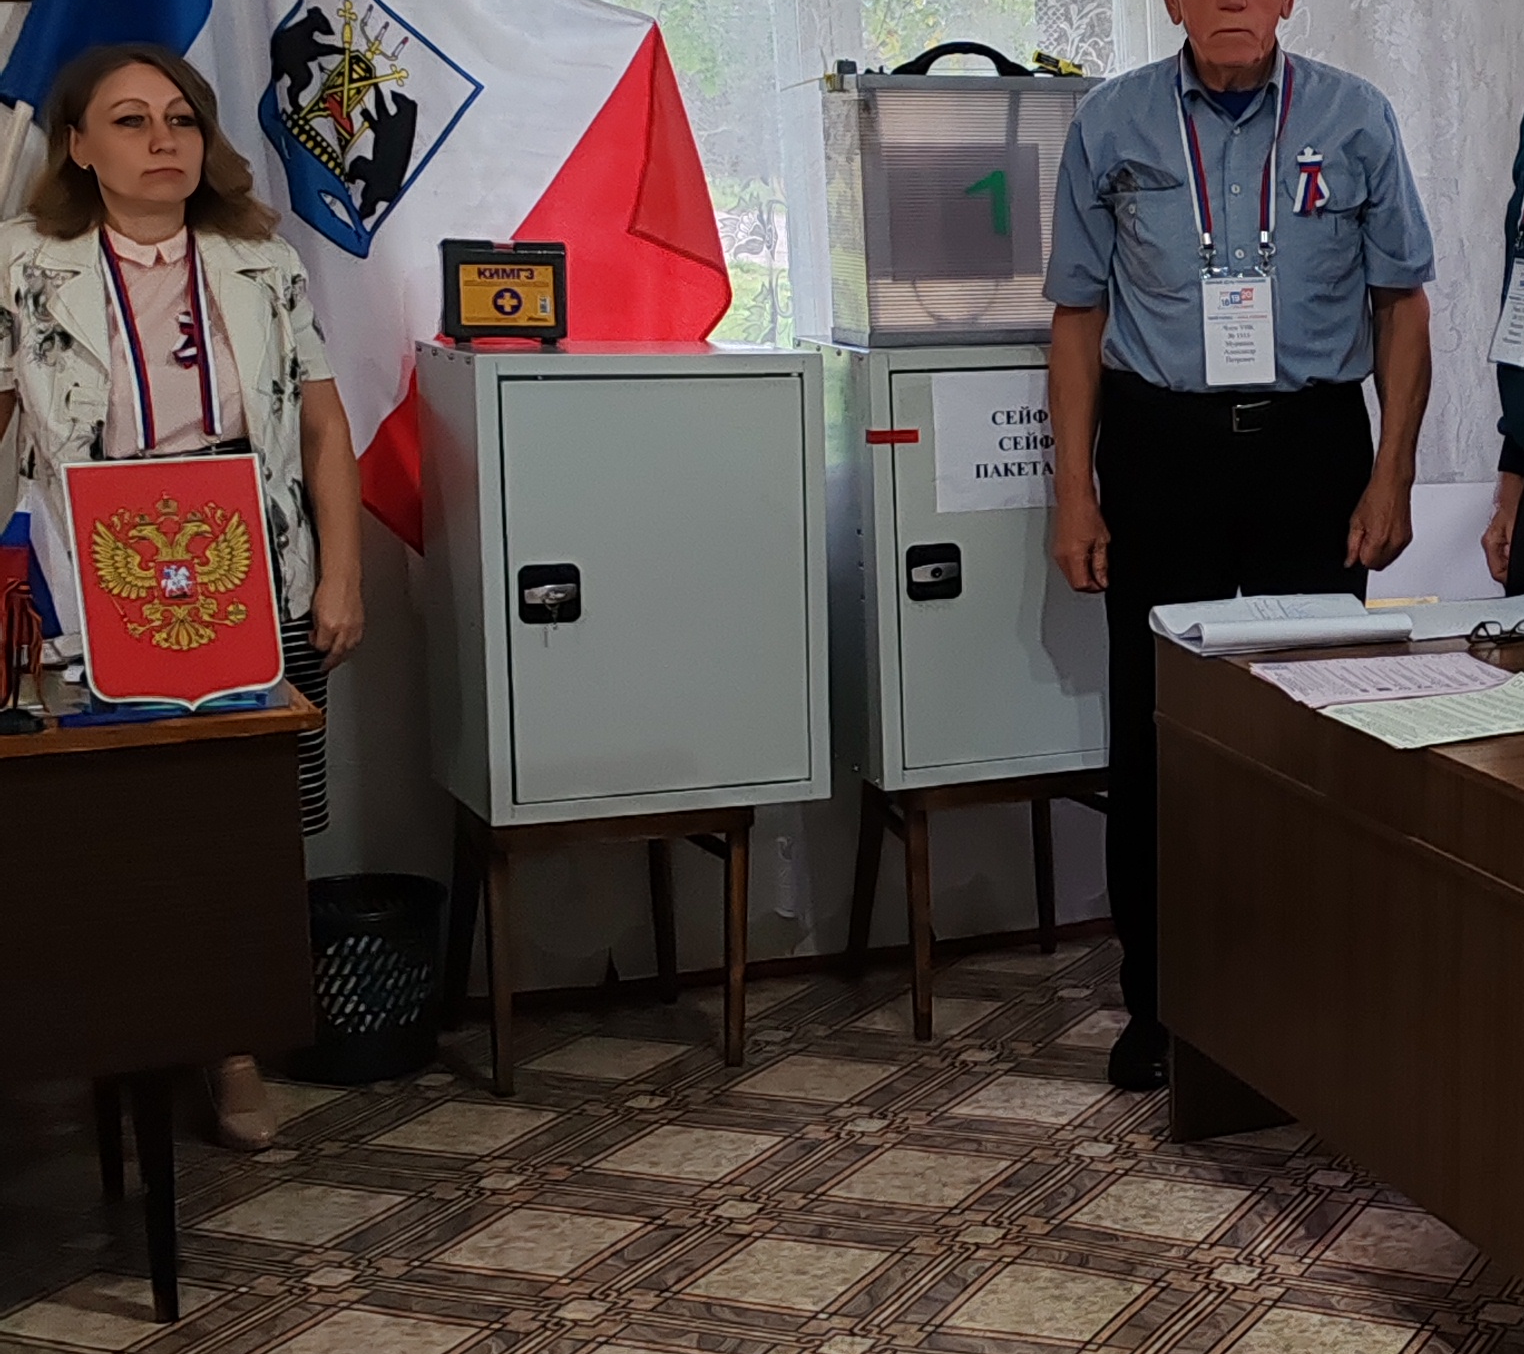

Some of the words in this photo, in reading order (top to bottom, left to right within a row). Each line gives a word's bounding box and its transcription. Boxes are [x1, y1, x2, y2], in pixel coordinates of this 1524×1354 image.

[964, 170, 1009, 235] 1
[477, 267, 535, 280] КИМГЗ
[991, 406, 1048, 425] СЕЙФ
[998, 432, 1055, 451] СЕЙФ
